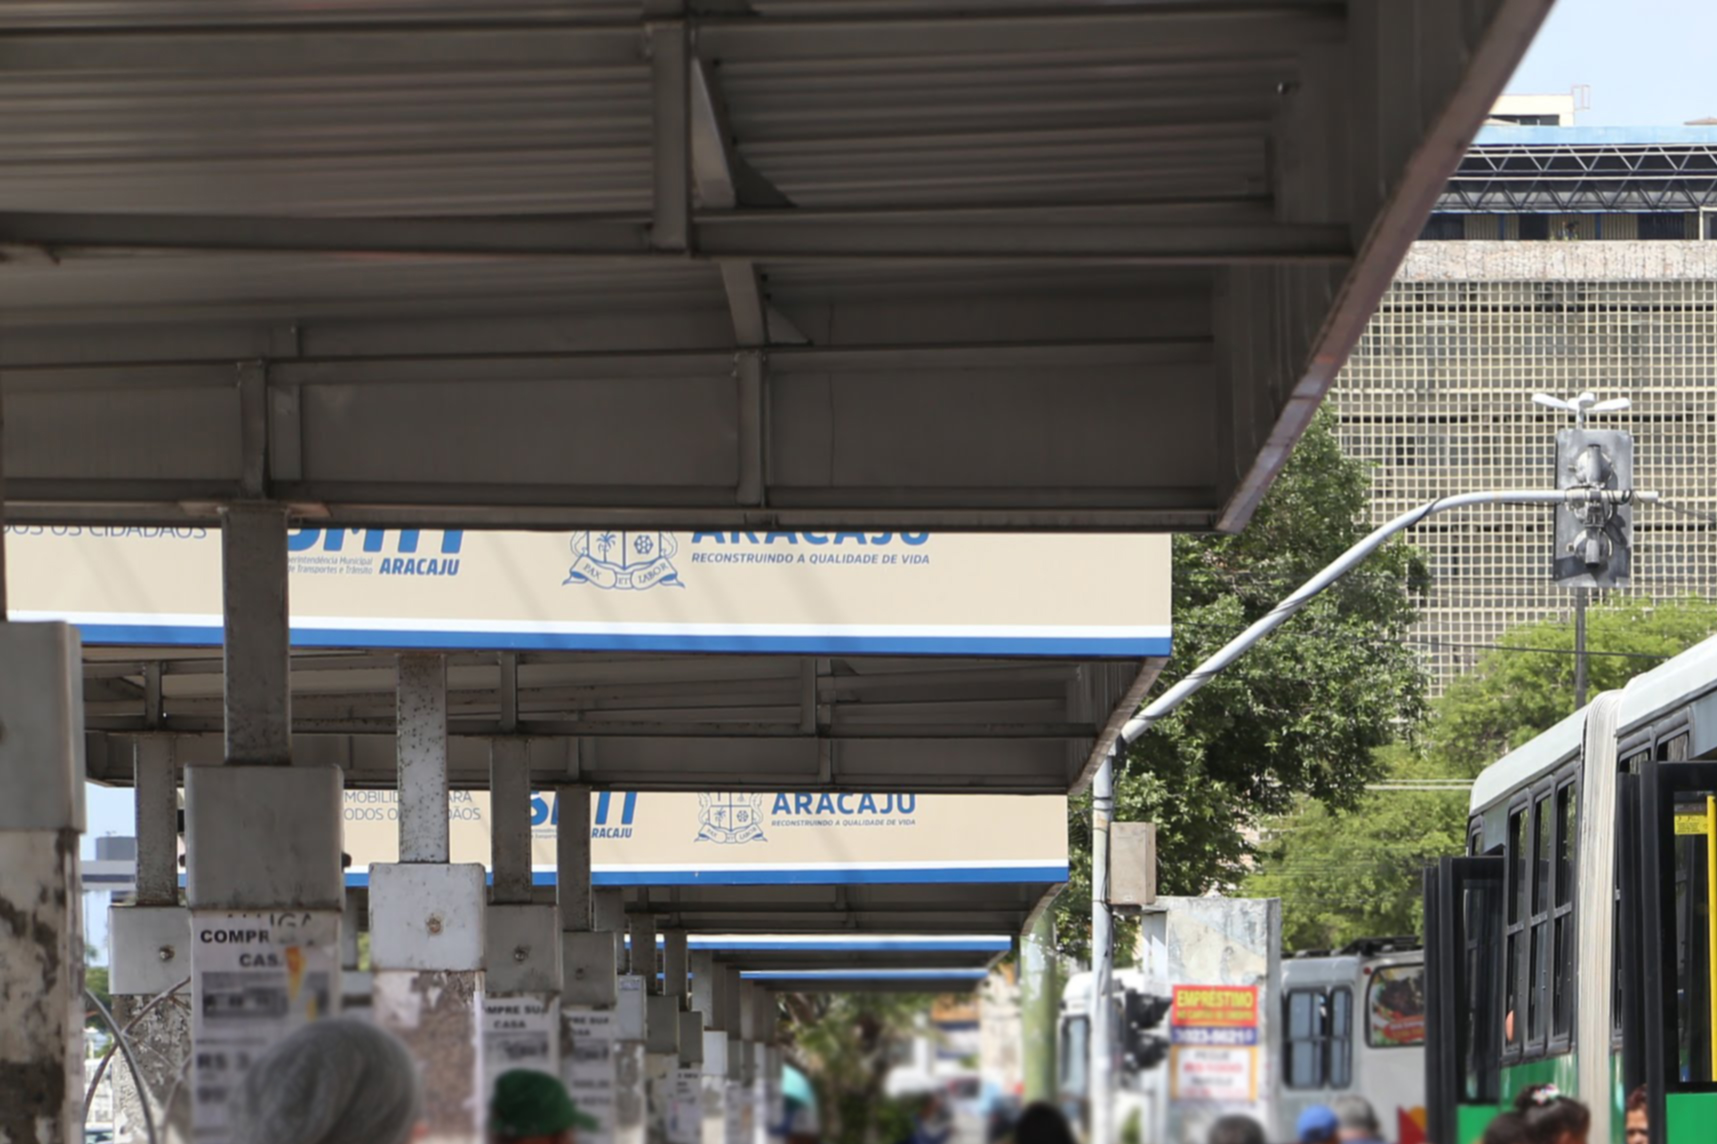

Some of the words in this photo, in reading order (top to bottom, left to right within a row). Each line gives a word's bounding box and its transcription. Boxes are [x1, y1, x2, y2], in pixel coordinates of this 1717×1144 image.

[691, 552, 793, 563] RECONSTRUINDO
[797, 554, 805, 563] A
[809, 554, 878, 565] QUALIDADE
[881, 554, 897, 564] DE
[901, 554, 930, 564] VIDA
[379, 557, 460, 576] ARACAJU
[583, 562, 601, 580] PAX
[638, 561, 668, 584] LABOR
[771, 792, 916, 815] ARACAJU
[771, 819, 833, 827] RECONSTRUINDO
[843, 819, 884, 827] QUALIDADE
[591, 827, 633, 838] RACAJU
[200, 929, 270, 944] COMPR
